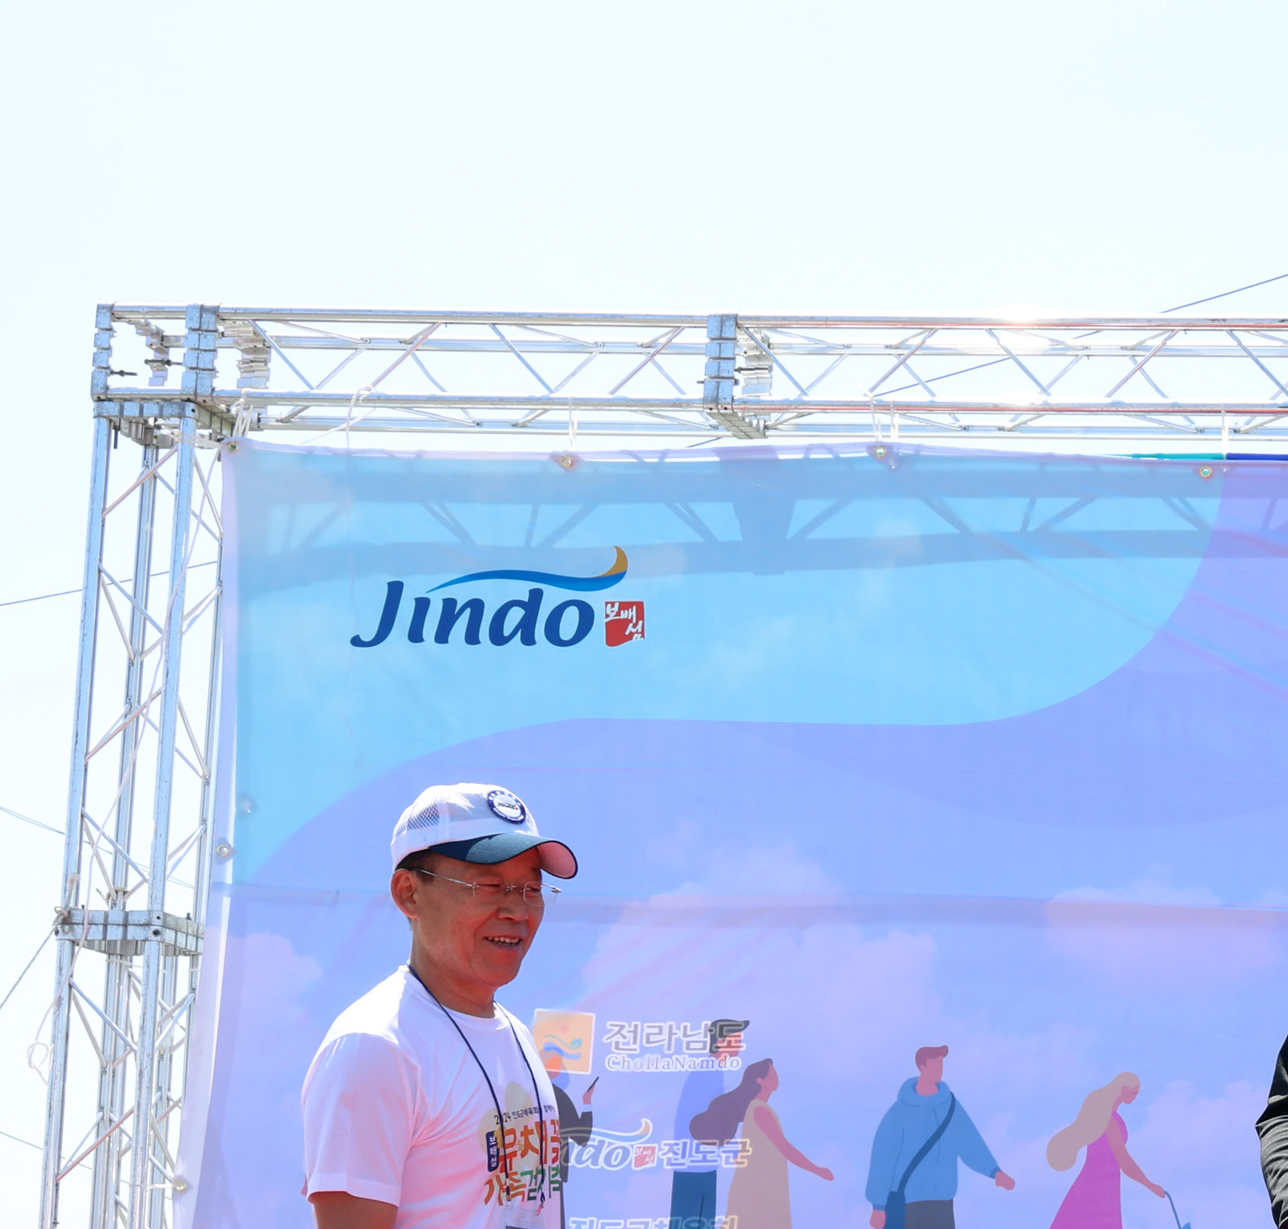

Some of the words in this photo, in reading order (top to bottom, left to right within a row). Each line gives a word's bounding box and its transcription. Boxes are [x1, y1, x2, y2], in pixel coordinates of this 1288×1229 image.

[351, 580, 594, 648] Jindo
[604, 1022, 745, 1052] 전라남도
[660, 1140, 751, 1168] 진도군
